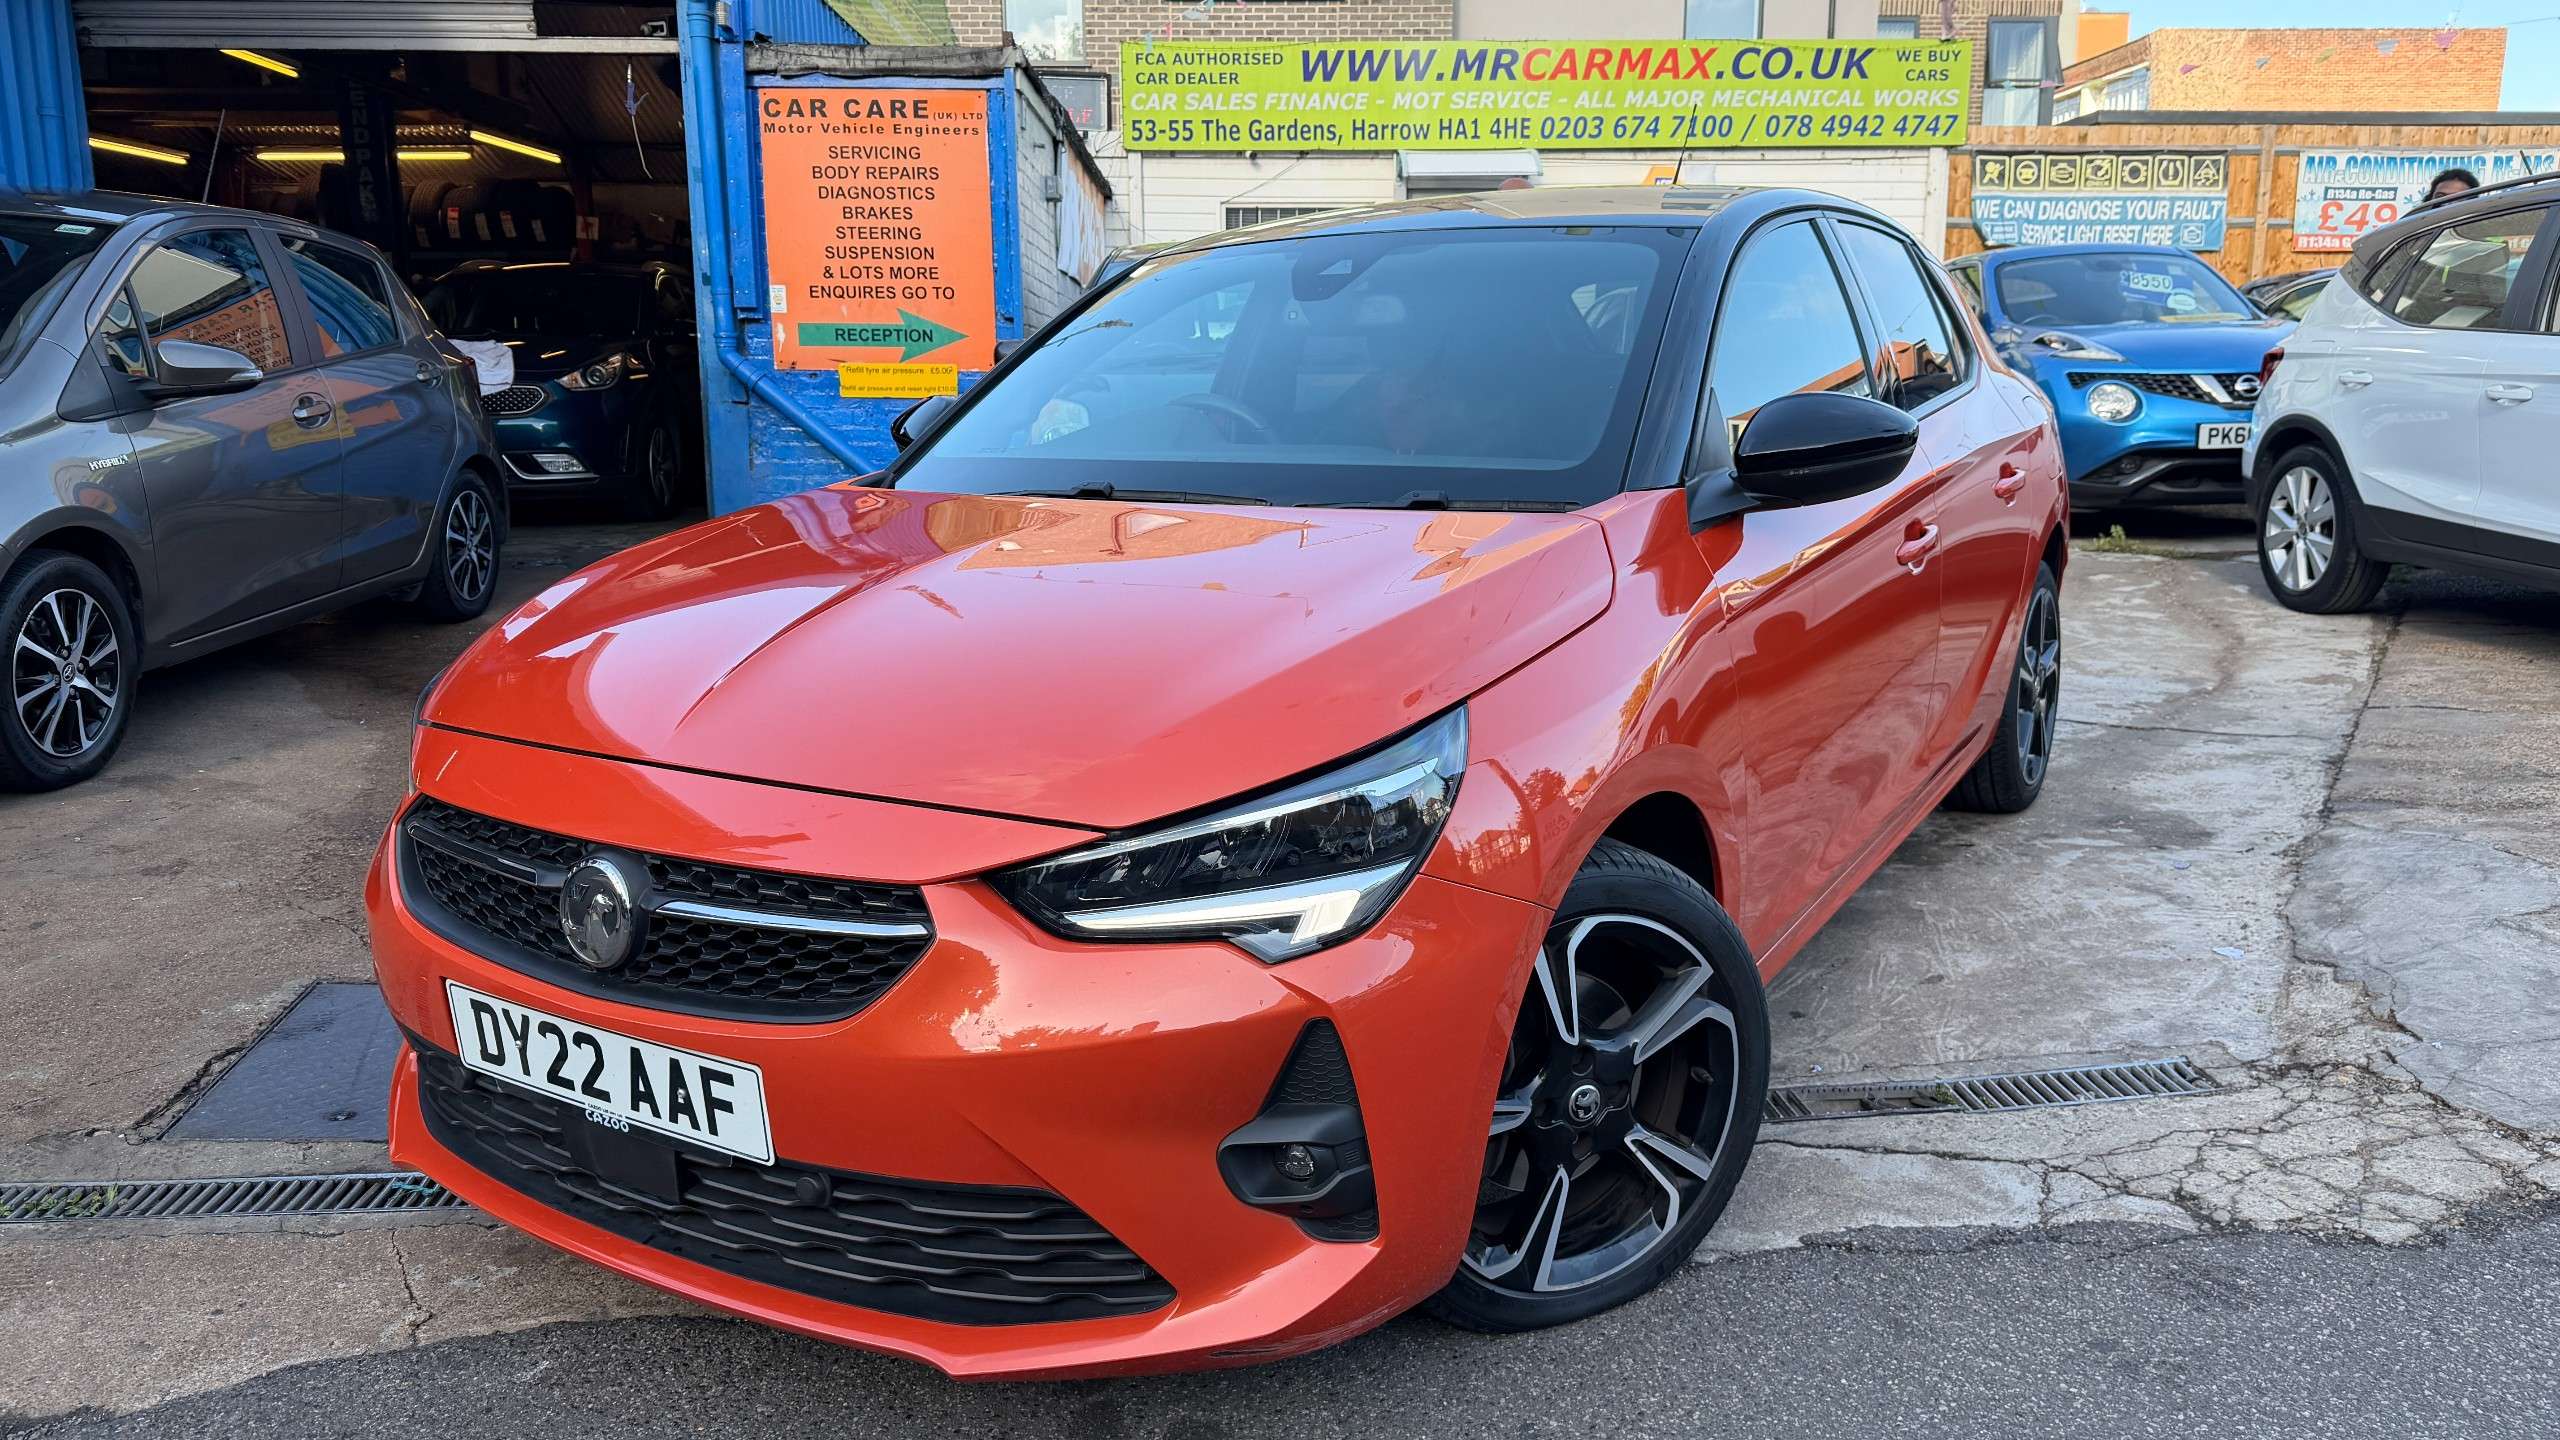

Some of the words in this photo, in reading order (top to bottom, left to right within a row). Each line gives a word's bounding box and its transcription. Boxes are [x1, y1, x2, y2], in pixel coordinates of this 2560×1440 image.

[1135, 53, 1166, 65] FCA
[1172, 52, 1284, 65] AUTHORISED
[1896, 50, 1923, 63] WE
[1928, 49, 1961, 63] BUY
[1301, 47, 1875, 82] WWW.MRCARMAX.CO.UK
[1135, 72, 1169, 85] CAR
[1174, 72, 1240, 85] DEALER
[1905, 68, 1949, 82] CARS
[1131, 93, 1177, 111] CAR
[1183, 92, 1257, 111] SALES
[1265, 92, 1368, 110] FINANCE
[1391, 92, 1444, 109] MOT
[1450, 91, 1550, 109] SERVICE
[1574, 90, 1616, 108] ALL
[1624, 90, 1705, 108] MAJOR
[1710, 89, 1864, 107] MECHANICAL
[1874, 89, 1960, 107] WORKS
[763, 98, 827, 118] CAR
[843, 98, 929, 119] CARE
[932, 112, 958, 121] (UK)
[962, 112, 983, 121] LTD
[764, 123, 812, 134] Motor
[820, 123, 885, 135] Vehicle
[893, 124, 980, 137] Engineers
[1131, 120, 1194, 142] 53-55
[1201, 119, 1241, 142] The
[1248, 118, 1343, 146] Gardens,
[1352, 118, 1430, 141] Harrow
[1439, 117, 1480, 140] HA1
[1490, 117, 1531, 139] 4HE
[1540, 116, 1603, 139] 0203
[1613, 116, 1660, 138] 674
[1670, 115, 1733, 138] 7100
[1765, 115, 1813, 138] 078
[1821, 114, 1884, 137] 4942
[1893, 114, 1959, 137] 4747
[828, 146, 921, 160] SERVICING
[812, 166, 860, 180] BODY
[866, 167, 939, 181] REPAIRS
[818, 186, 936, 200] DIAGNOSTICS
[843, 206, 913, 220] BRAKES
[1975, 200, 2001, 219] WE
[2004, 200, 2036, 219] CAN
[2038, 200, 2122, 220] DIAGNOSE
[2126, 200, 2170, 220] YOUR
[2172, 200, 2224, 220] FAULT
[835, 226, 922, 240] STEERING
[2021, 223, 2066, 244] SERVICE
[2067, 223, 2102, 245] LIGHT
[2103, 223, 2139, 245] RESET
[2142, 224, 2174, 245] HERE
[825, 246, 935, 260] SUSPENSION
[823, 266, 834, 279] &
[840, 266, 884, 280] LOTS
[890, 266, 939, 280] MORE
[809, 285, 897, 300] ENQUIRES
[901, 286, 928, 300] GO
[931, 286, 955, 300] TO
[835, 328, 933, 343] RECEPTION
[88, 457, 123, 471] HYBRID
[469, 997, 612, 1103] DY22
[629, 1046, 735, 1137] AAF
[585, 1109, 629, 1132] CAZOO
